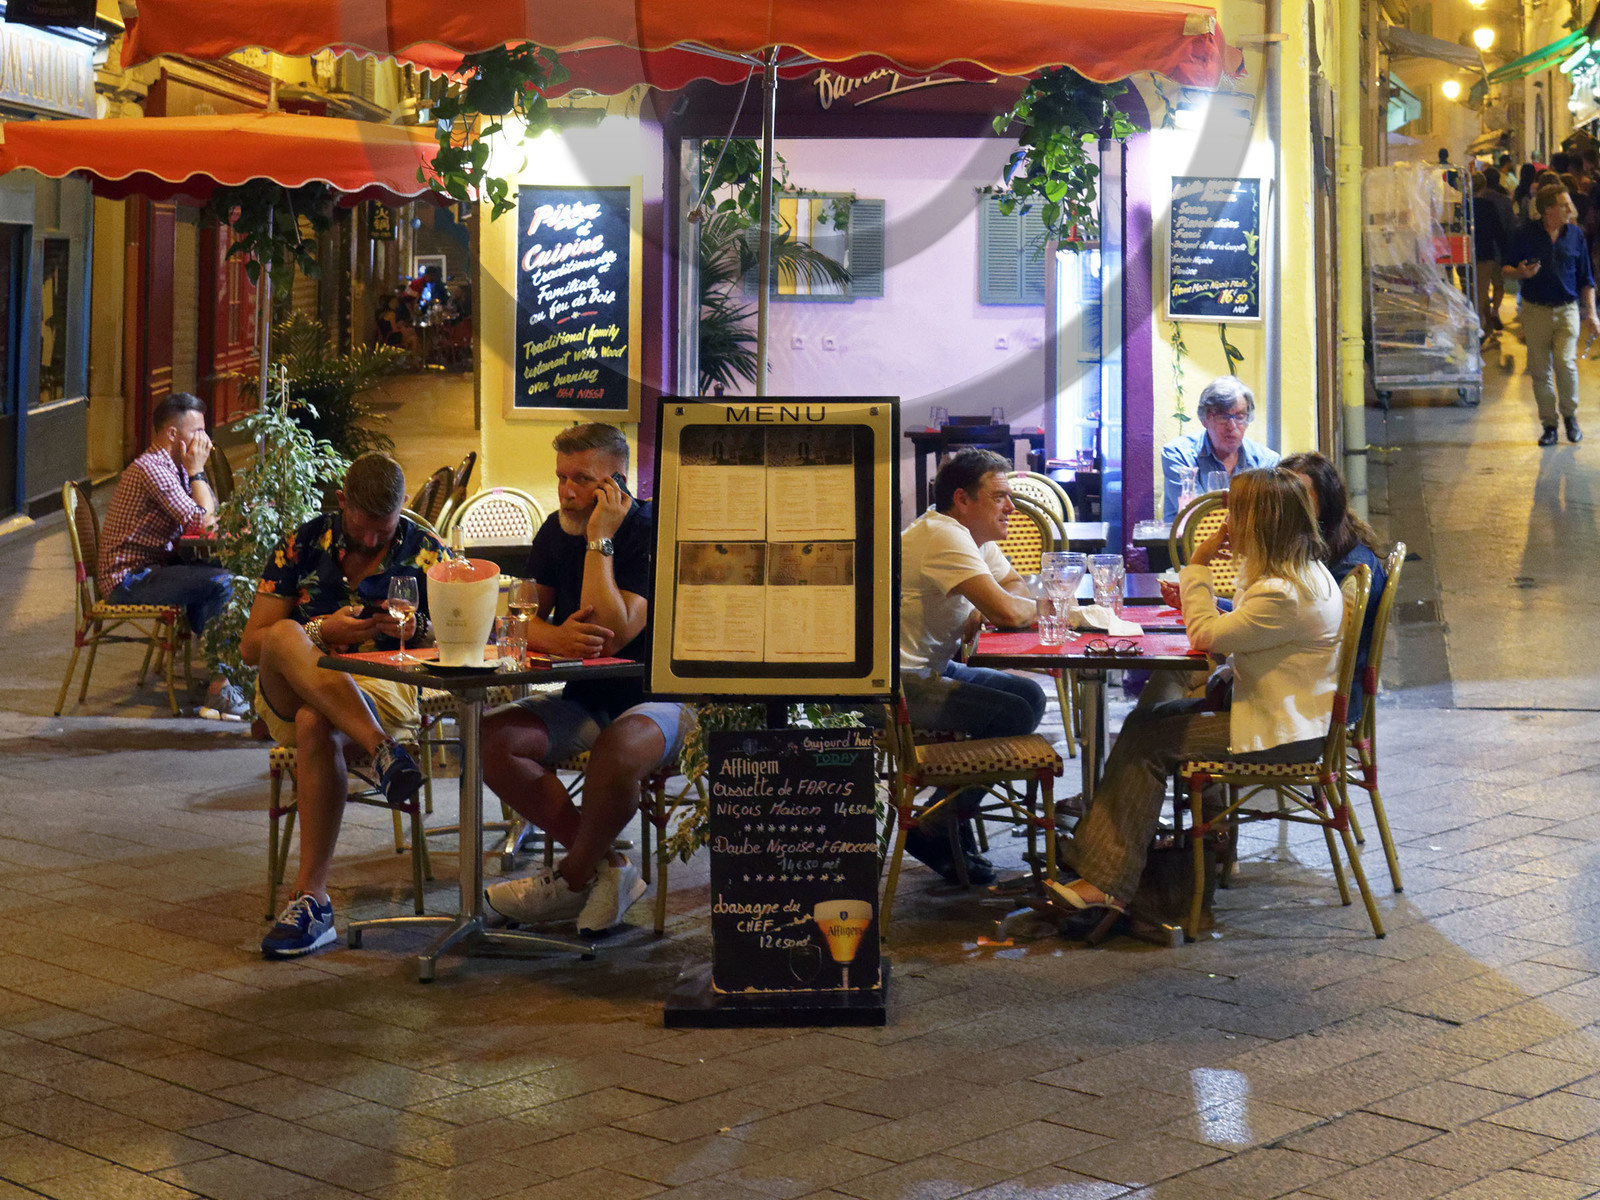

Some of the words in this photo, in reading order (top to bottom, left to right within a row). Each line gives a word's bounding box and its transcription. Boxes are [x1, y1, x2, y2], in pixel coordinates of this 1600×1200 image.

[527, 200, 602, 236] Pizza
[576, 221, 594, 237] et
[521, 234, 605, 272] Cuisine
[531, 250, 618, 286] traditionnelle
[537, 274, 600, 305] Familiale
[529, 310, 546, 326] au
[549, 300, 570, 320] feu
[571, 293, 587, 308] de
[588, 288, 616, 305] Bois
[523, 327, 586, 360] Traditional
[587, 323, 620, 346] family
[553, 368, 600, 387] burning
[726, 406, 826, 423] MENU
[812, 753, 859, 764] TODAY
[719, 758, 779, 780] Affligem
[778, 778, 793, 797] de
[769, 800, 822, 817] Maison
[712, 835, 763, 855] Daube
[782, 898, 801, 913] du
[736, 919, 775, 934] CHEF
